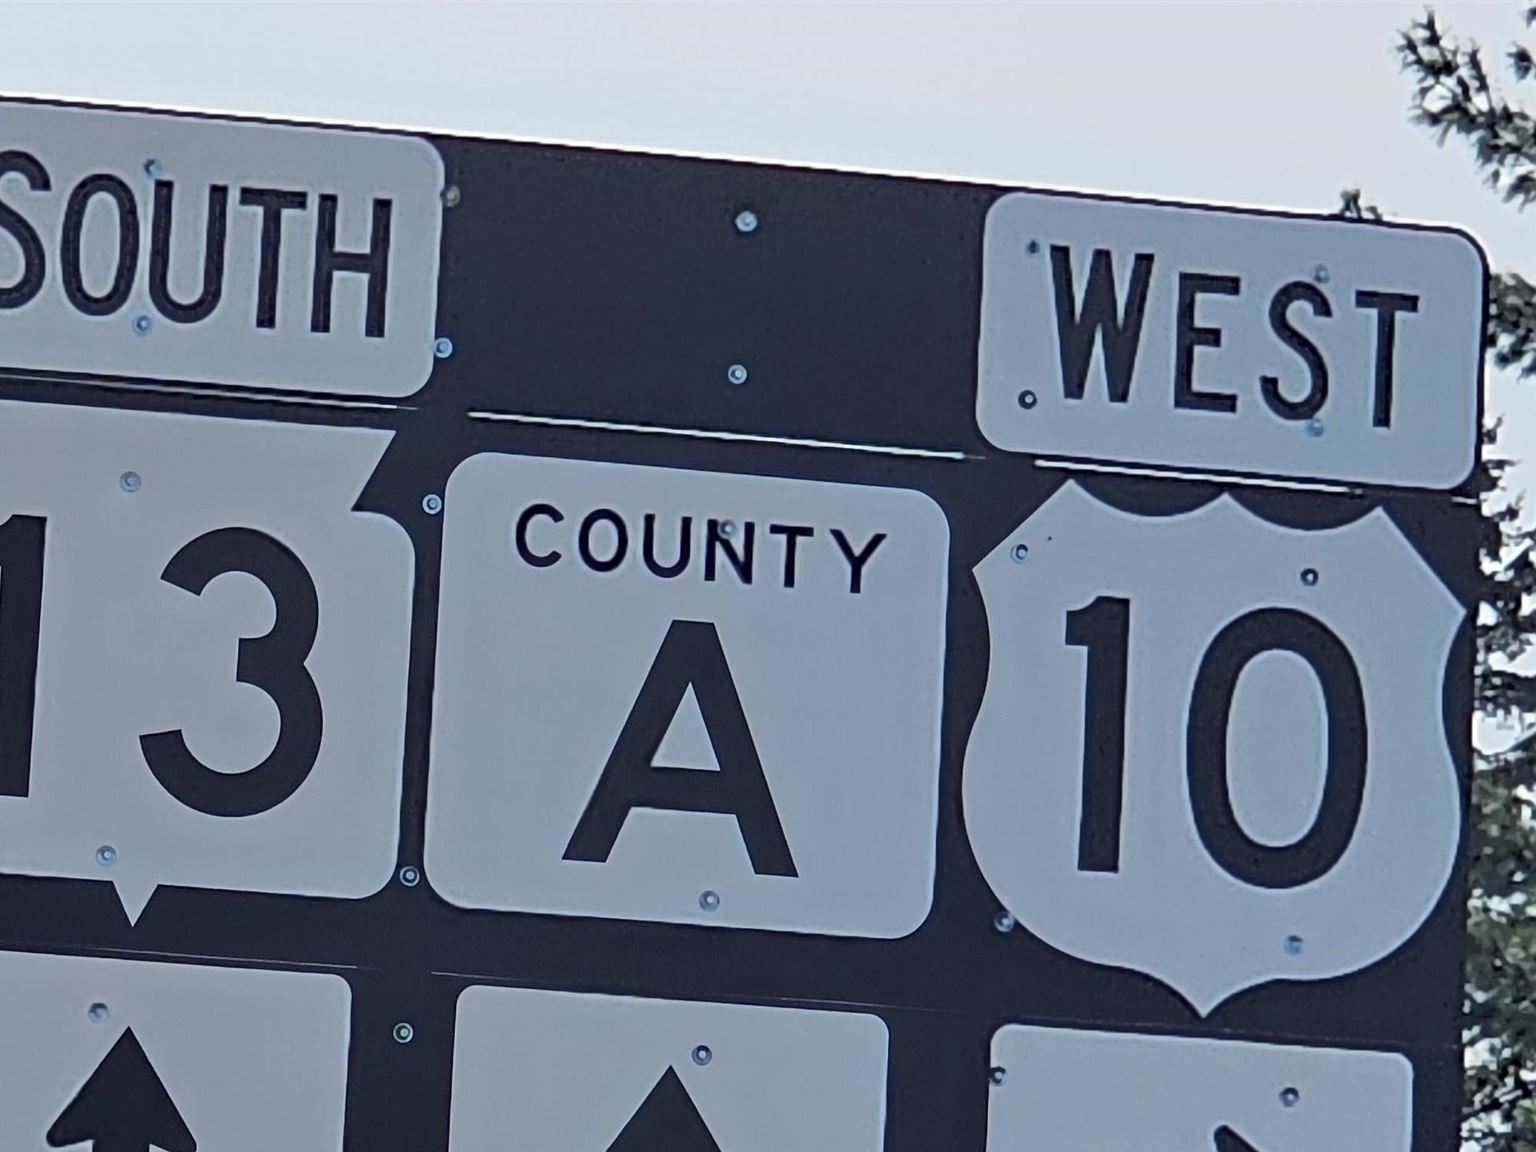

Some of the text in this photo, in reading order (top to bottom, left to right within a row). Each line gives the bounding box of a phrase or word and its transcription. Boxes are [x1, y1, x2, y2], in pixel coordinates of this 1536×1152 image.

[1048, 242, 1422, 431] WEST
[514, 502, 889, 596] COUNTY
[560, 618, 801, 880] A
[1063, 594, 1370, 891] 10
